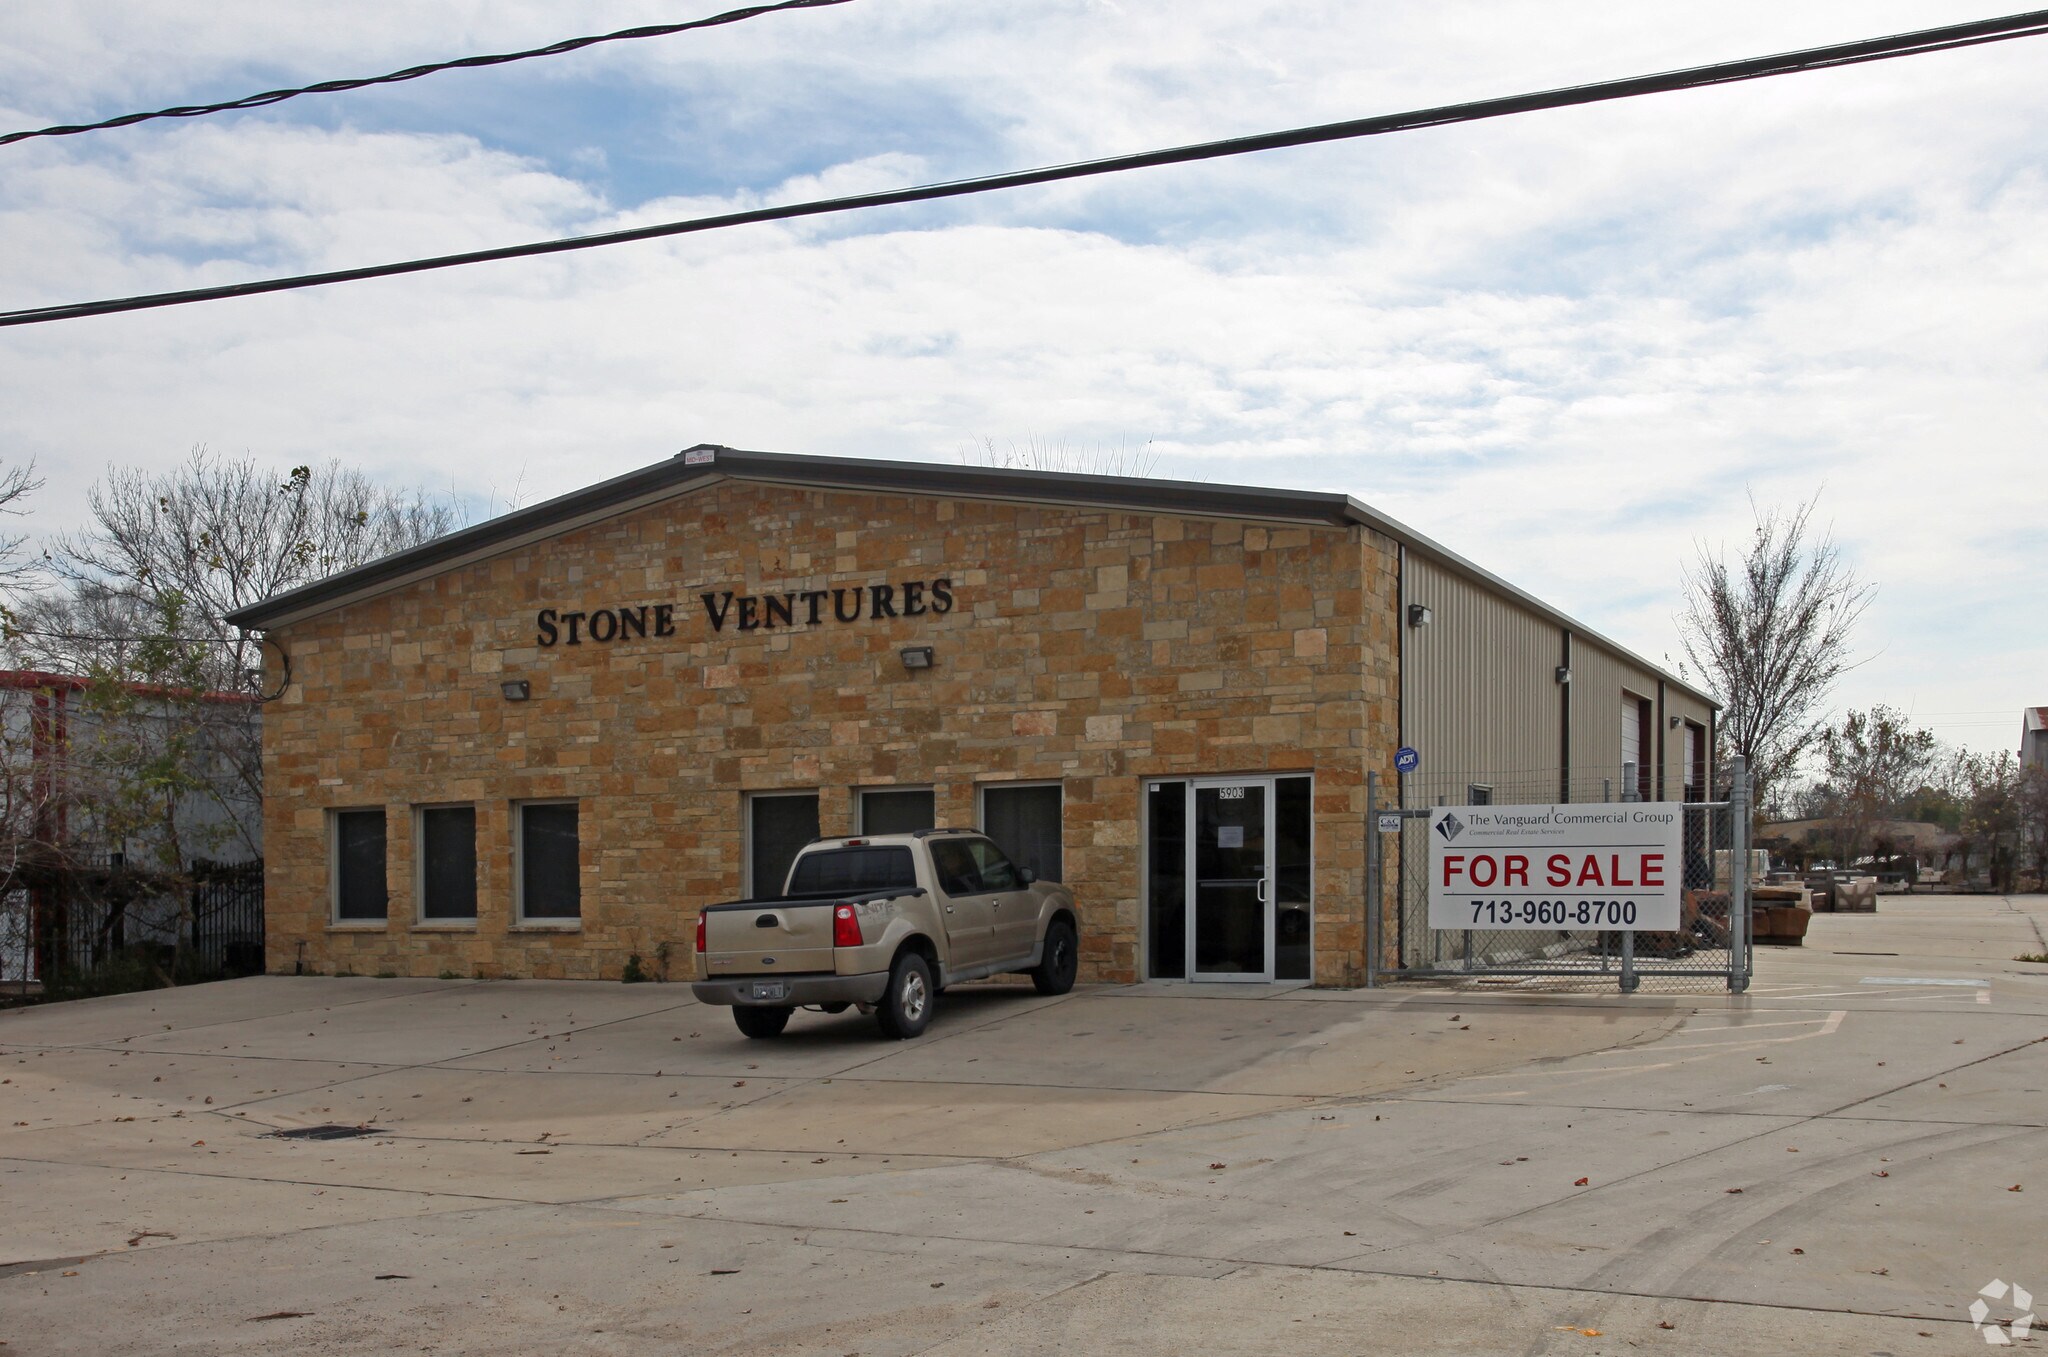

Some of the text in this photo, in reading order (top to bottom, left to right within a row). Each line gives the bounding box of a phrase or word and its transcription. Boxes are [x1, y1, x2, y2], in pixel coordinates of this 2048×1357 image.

[537, 578, 953, 647] STONE VENTURES
[1398, 753, 1415, 766] ADT
[1220, 787, 1244, 798] 5903
[1468, 811, 1674, 827] The Vanguard Commercial Group
[1443, 854, 1665, 887] FOR SALE
[1470, 900, 1637, 925] 713-960-8700
